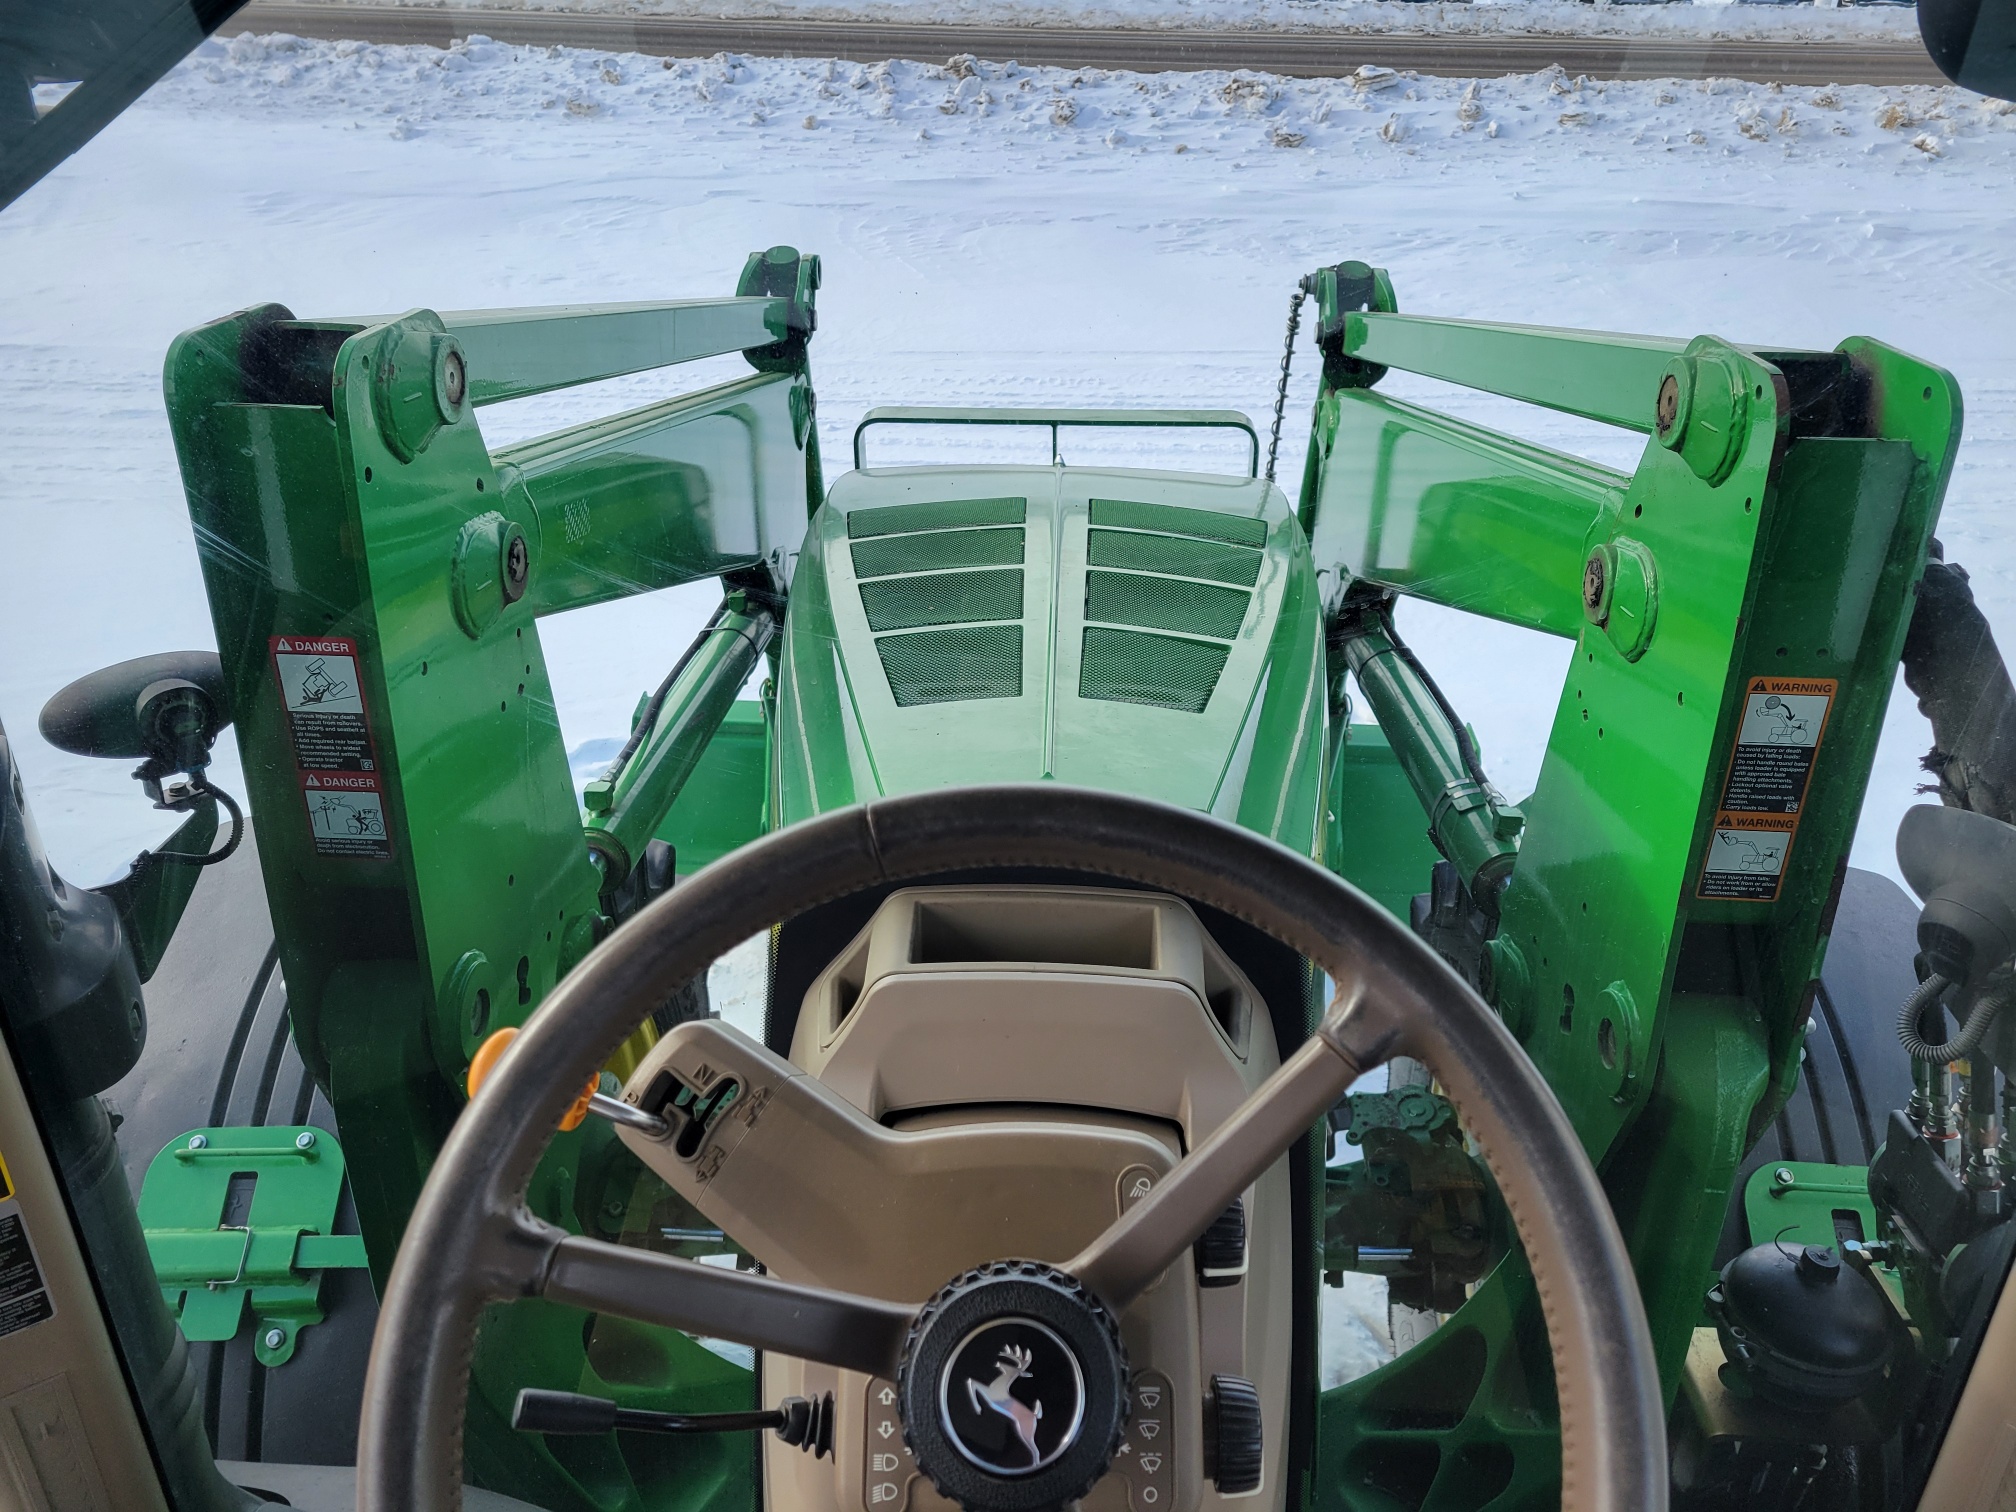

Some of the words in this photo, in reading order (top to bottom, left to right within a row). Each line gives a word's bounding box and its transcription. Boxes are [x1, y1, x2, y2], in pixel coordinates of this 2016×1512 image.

[295, 642, 349, 652] DANGER
[1772, 682, 1832, 693] WARNING
[324, 777, 375, 788] DANGER
[1736, 818, 1794, 828] WARNING
[692, 1064, 716, 1086] N
